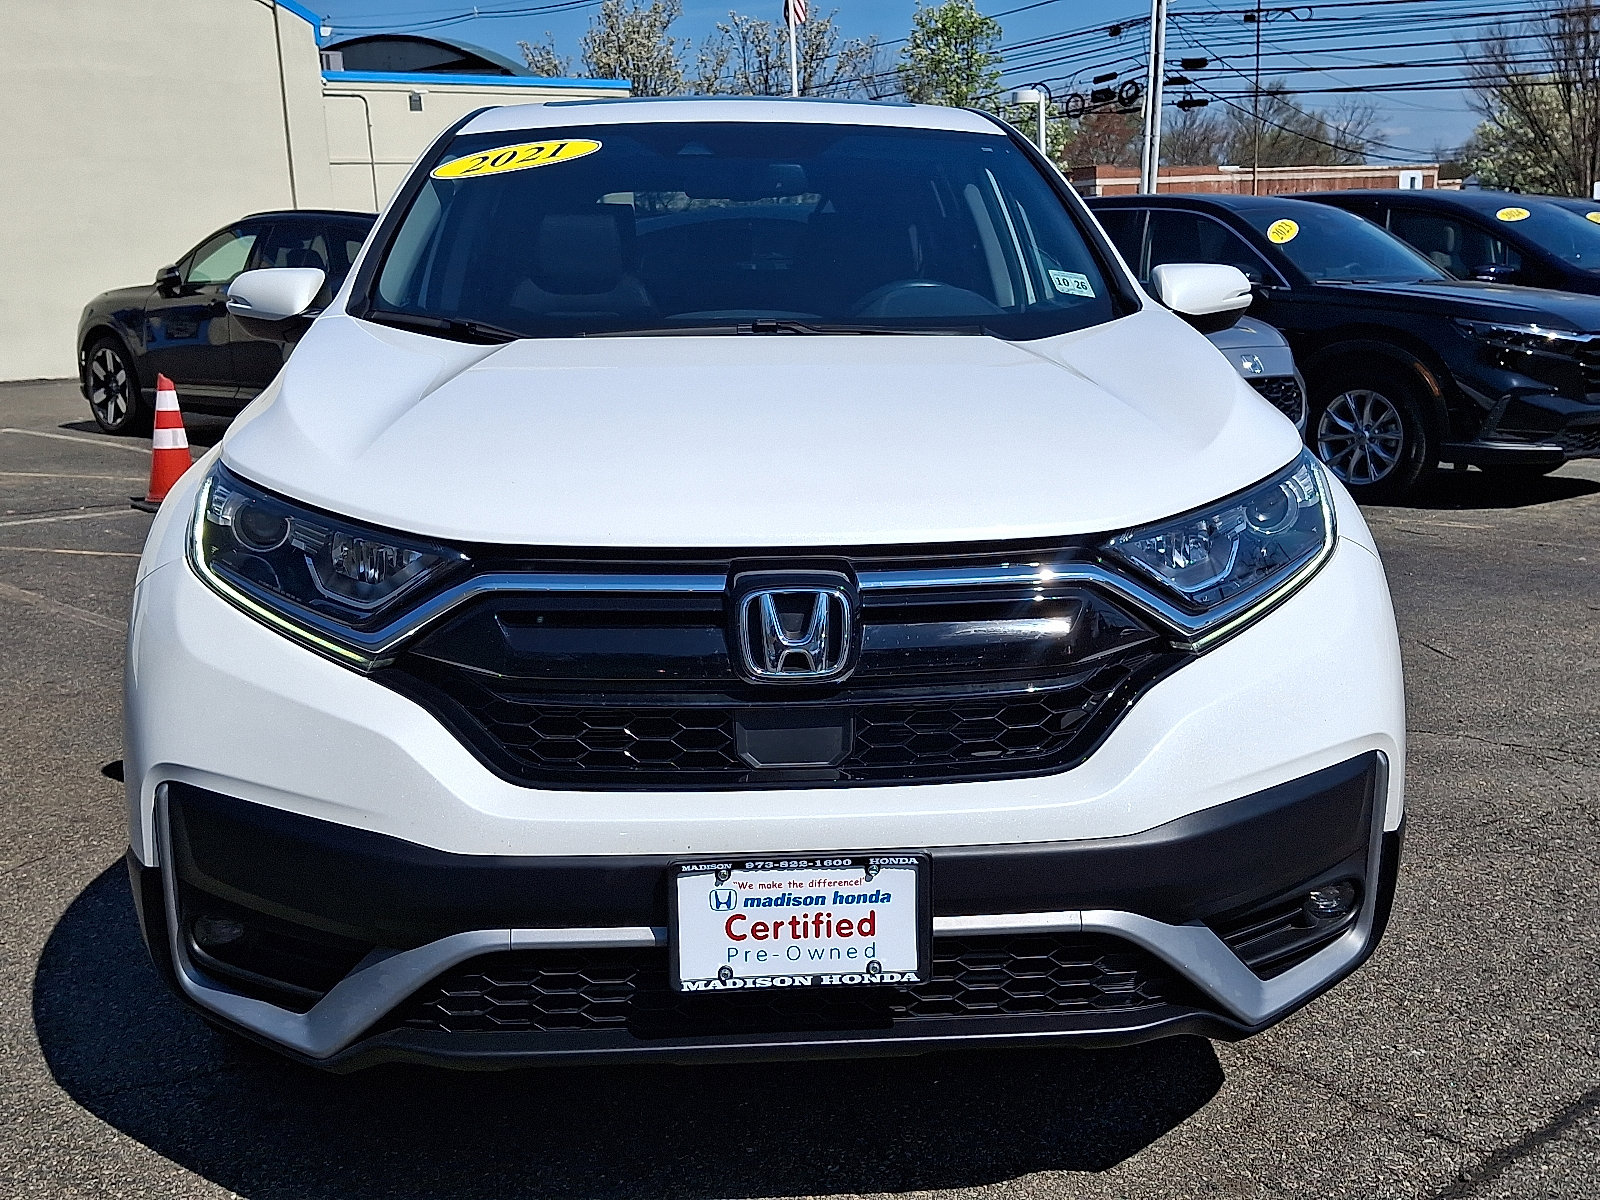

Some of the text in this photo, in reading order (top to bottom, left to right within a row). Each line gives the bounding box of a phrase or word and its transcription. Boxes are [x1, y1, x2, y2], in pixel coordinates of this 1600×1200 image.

[459, 142, 569, 175] 2021
[1055, 276, 1088, 291] 10 26
[681, 857, 919, 872] MADISON 973-822-1600 HONDA
[758, 880, 783, 890] make
[787, 879, 805, 889] the
[743, 892, 827, 908] madison
[832, 889, 892, 905] honda
[724, 909, 877, 942] Certified
[727, 941, 877, 963] Pre-Owned
[680, 971, 921, 992] MADISON HONDA
